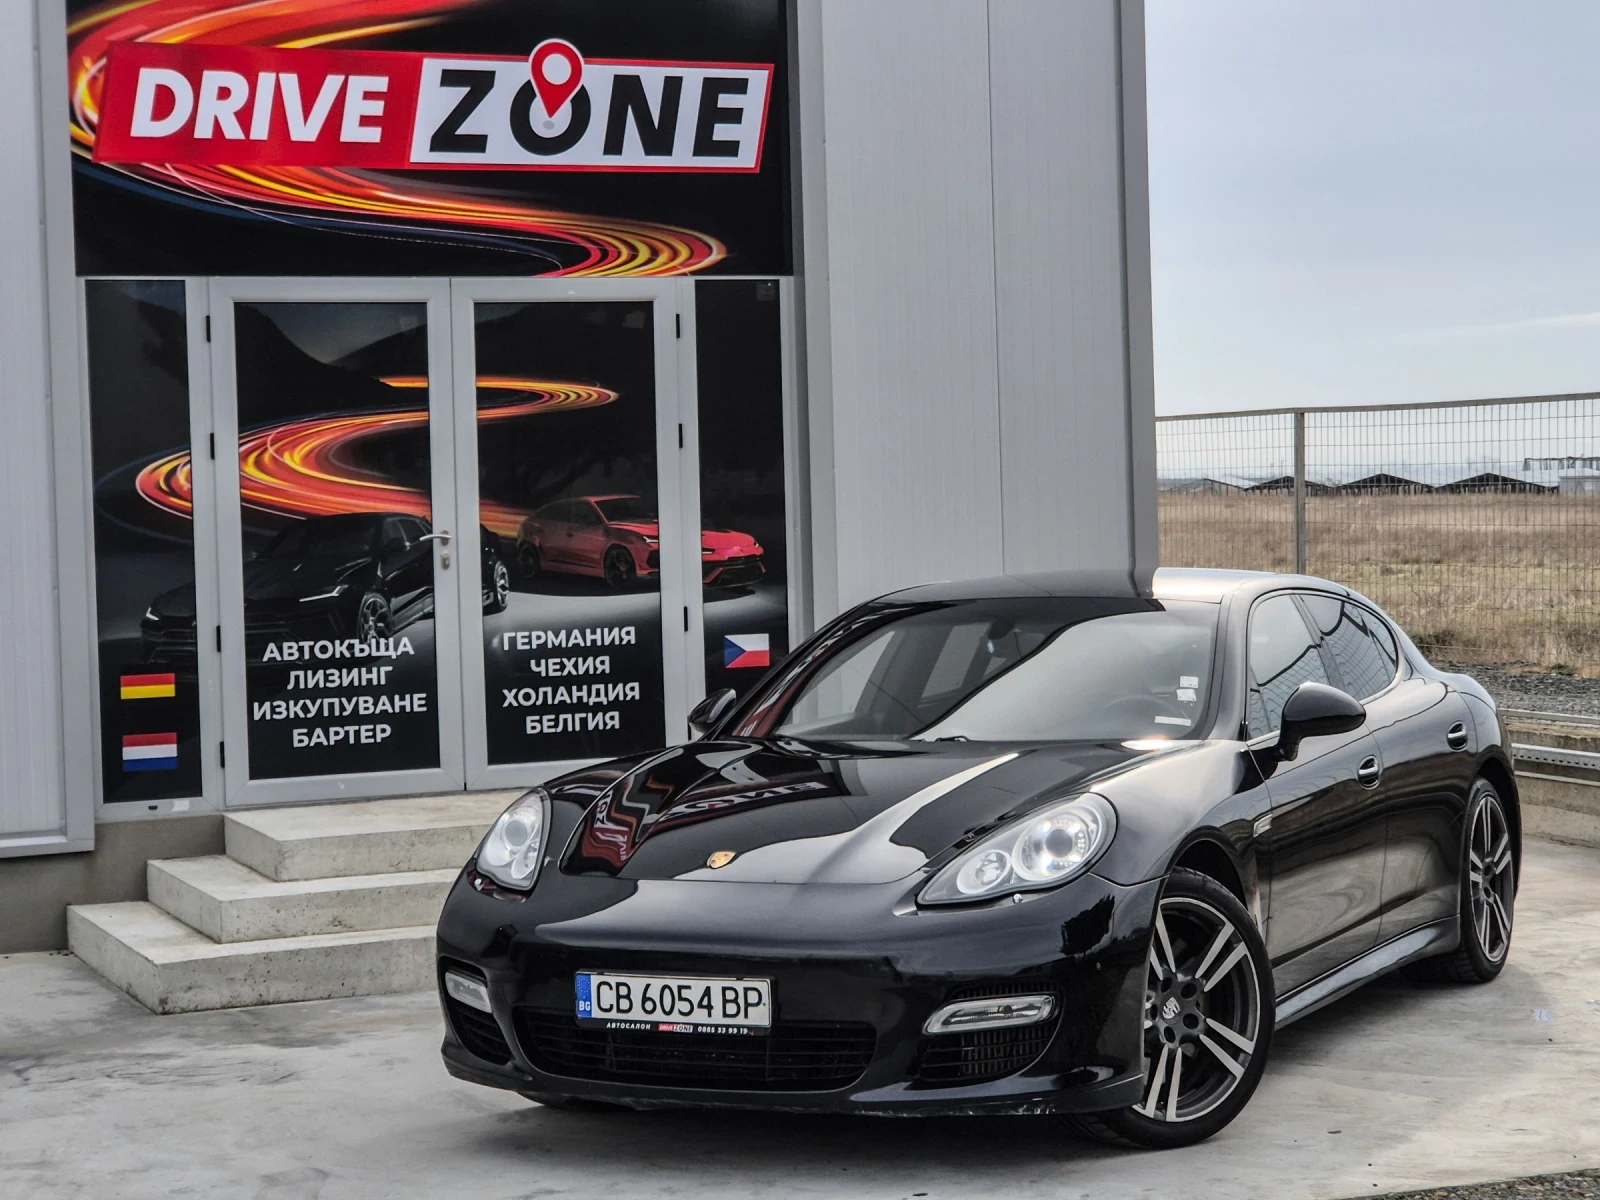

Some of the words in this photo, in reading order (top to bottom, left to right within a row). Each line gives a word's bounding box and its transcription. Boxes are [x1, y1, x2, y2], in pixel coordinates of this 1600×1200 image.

[129, 66, 389, 145] DRIVE
[429, 68, 750, 157] ZONE
[262, 636, 415, 662] АВТОКЪЩА
[503, 626, 636, 651] ГЕРМАНИЯ
[287, 666, 393, 690] ЛИЗИНГ
[530, 655, 611, 677] ЧЕХИЯ
[253, 693, 428, 721] ИЗКУПУВАНЕ
[502, 682, 640, 708] ХОЛАНДИЯ
[525, 711, 620, 735] БЕЛГИЯ
[292, 724, 392, 748] БАРТЕР
[578, 1000, 591, 1011] BG
[596, 980, 634, 1014] CB
[640, 983, 715, 1018] 6054
[721, 986, 764, 1019] BP
[606, 1022, 651, 1030] АВТОСАЛОН
